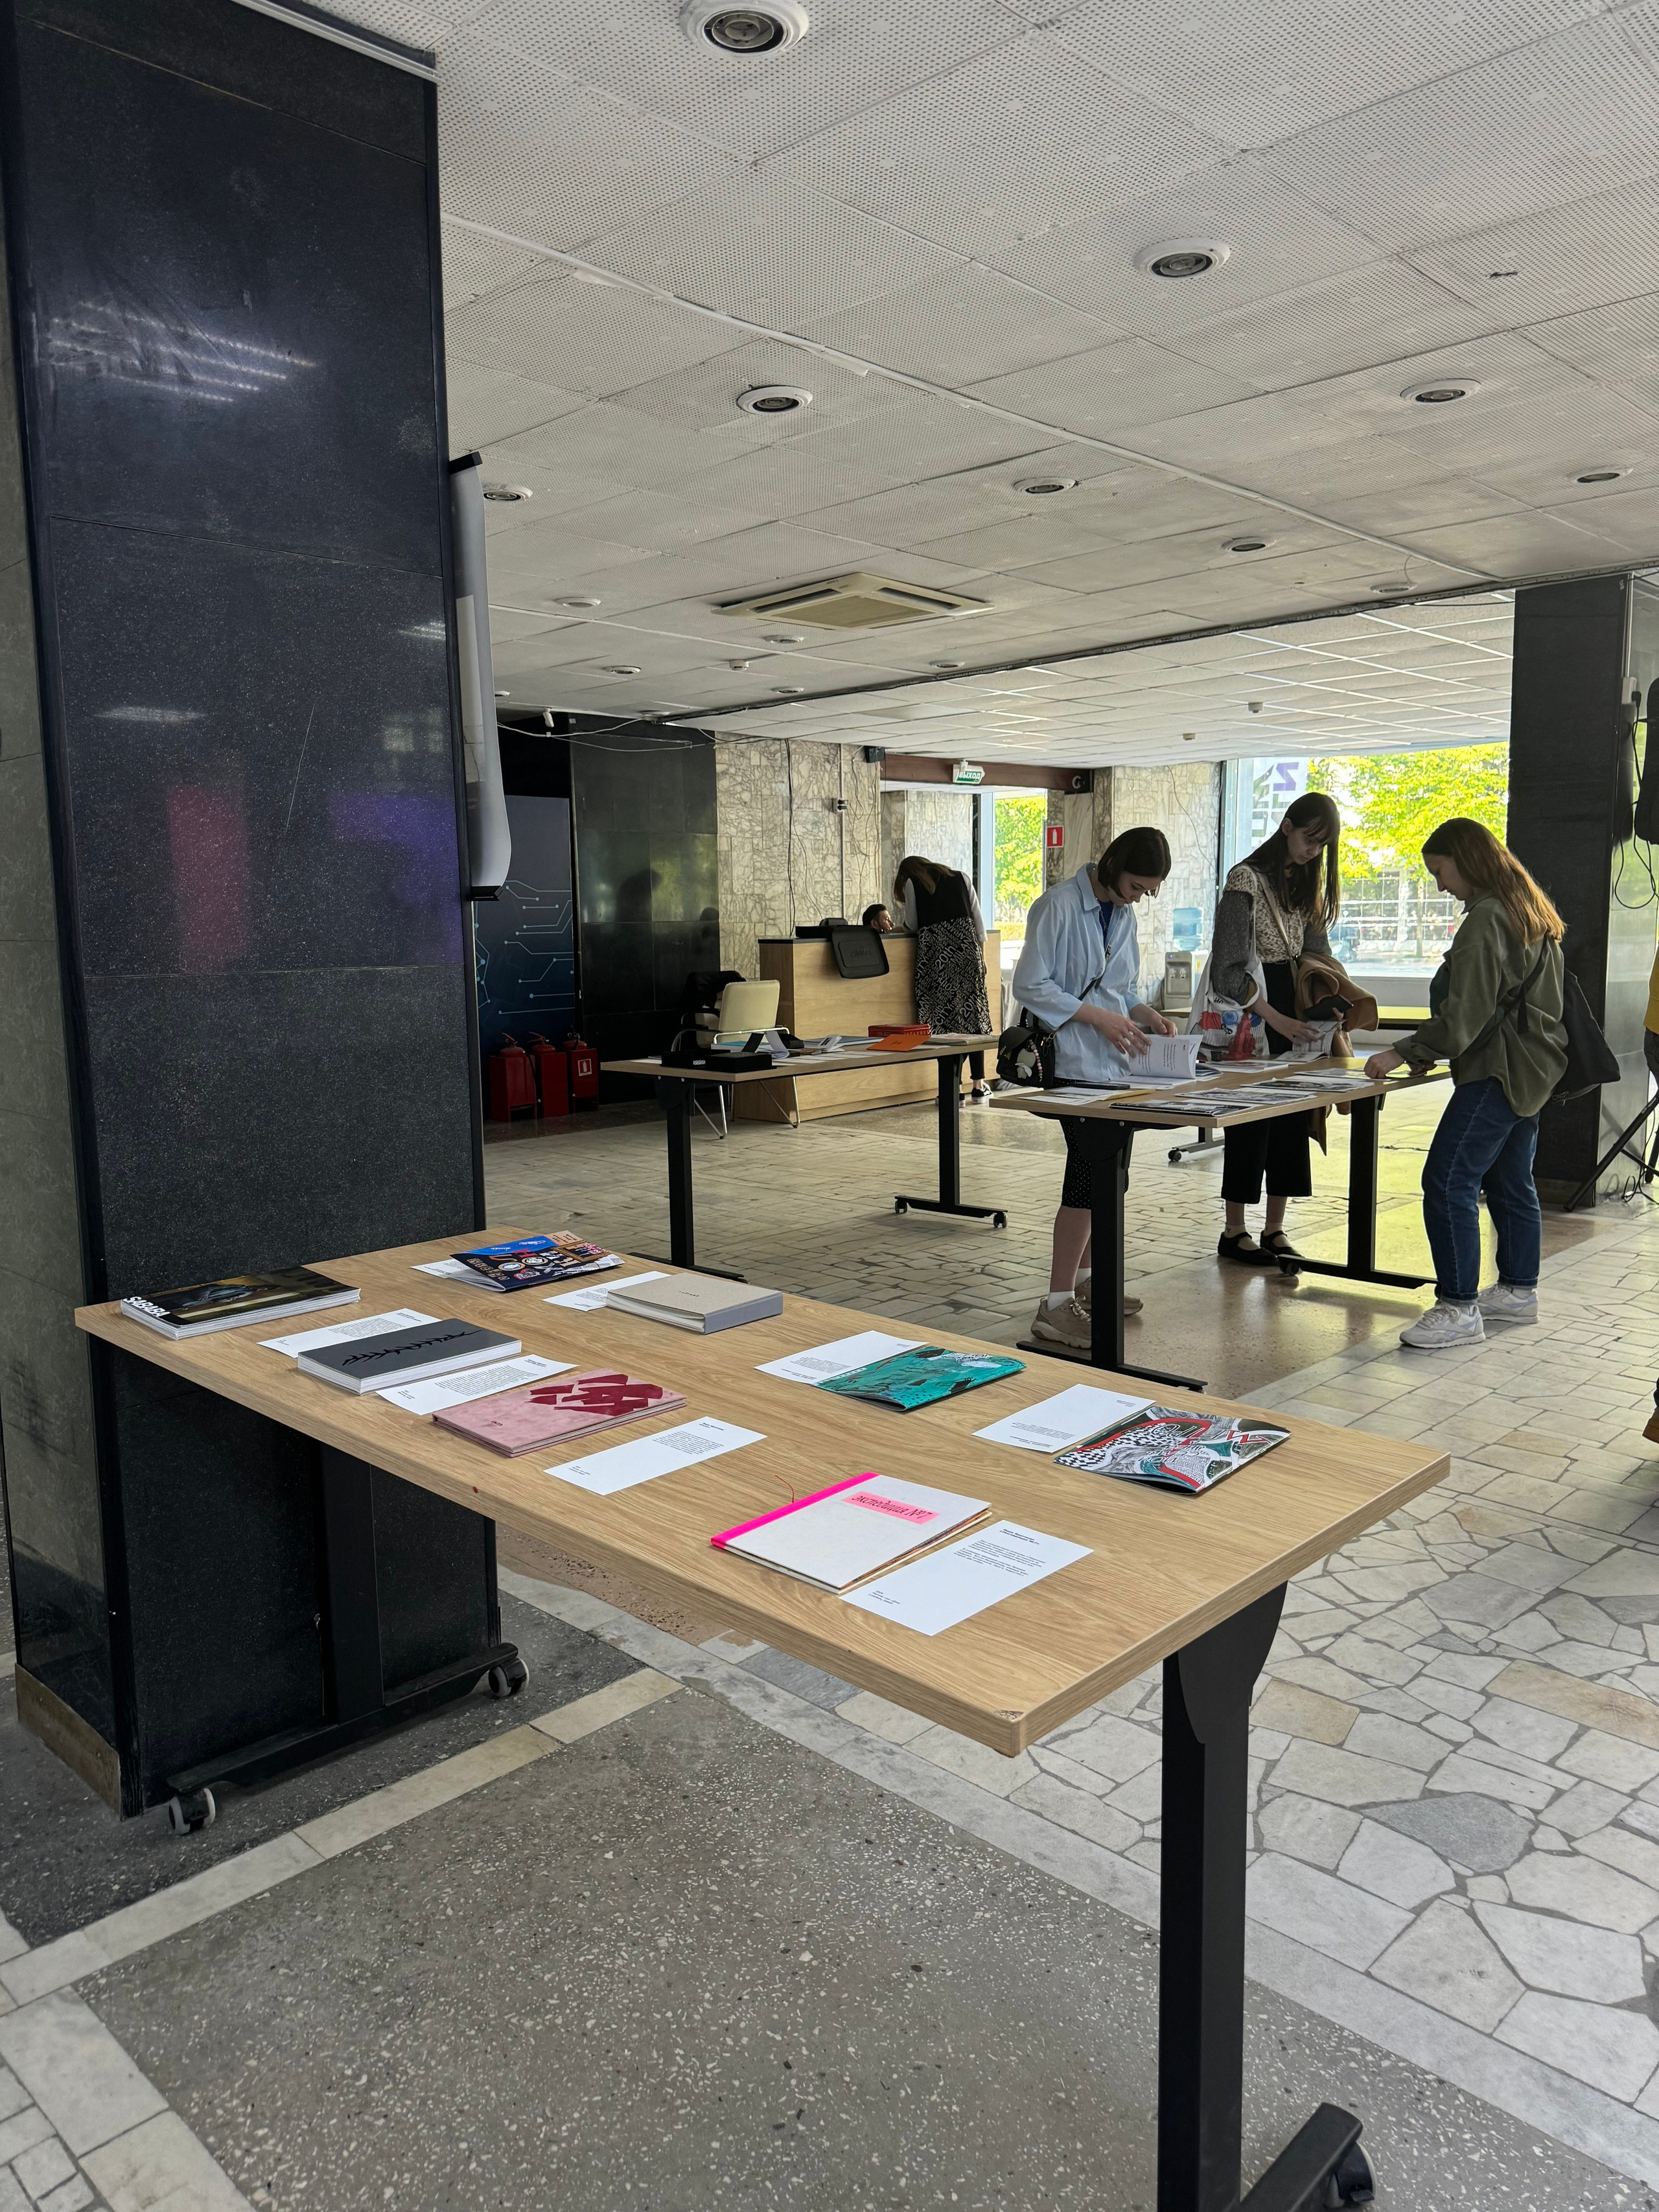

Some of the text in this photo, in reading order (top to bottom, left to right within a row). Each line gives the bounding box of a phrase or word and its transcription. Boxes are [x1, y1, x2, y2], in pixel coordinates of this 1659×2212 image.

[958, 772, 981, 780] ВЫХОД
[934, 946, 956, 970] 20th
[947, 960, 961, 973] NEW
[931, 964, 949, 981] MILAN
[924, 975, 954, 1000] NEW YORK
[930, 987, 948, 1003] SINCE
[937, 976, 957, 994] 20th
[933, 1003, 954, 1026] CITY
[122, 1296, 171, 1318] SABABA
[852, 1495, 933, 1519] экспедиция №7
